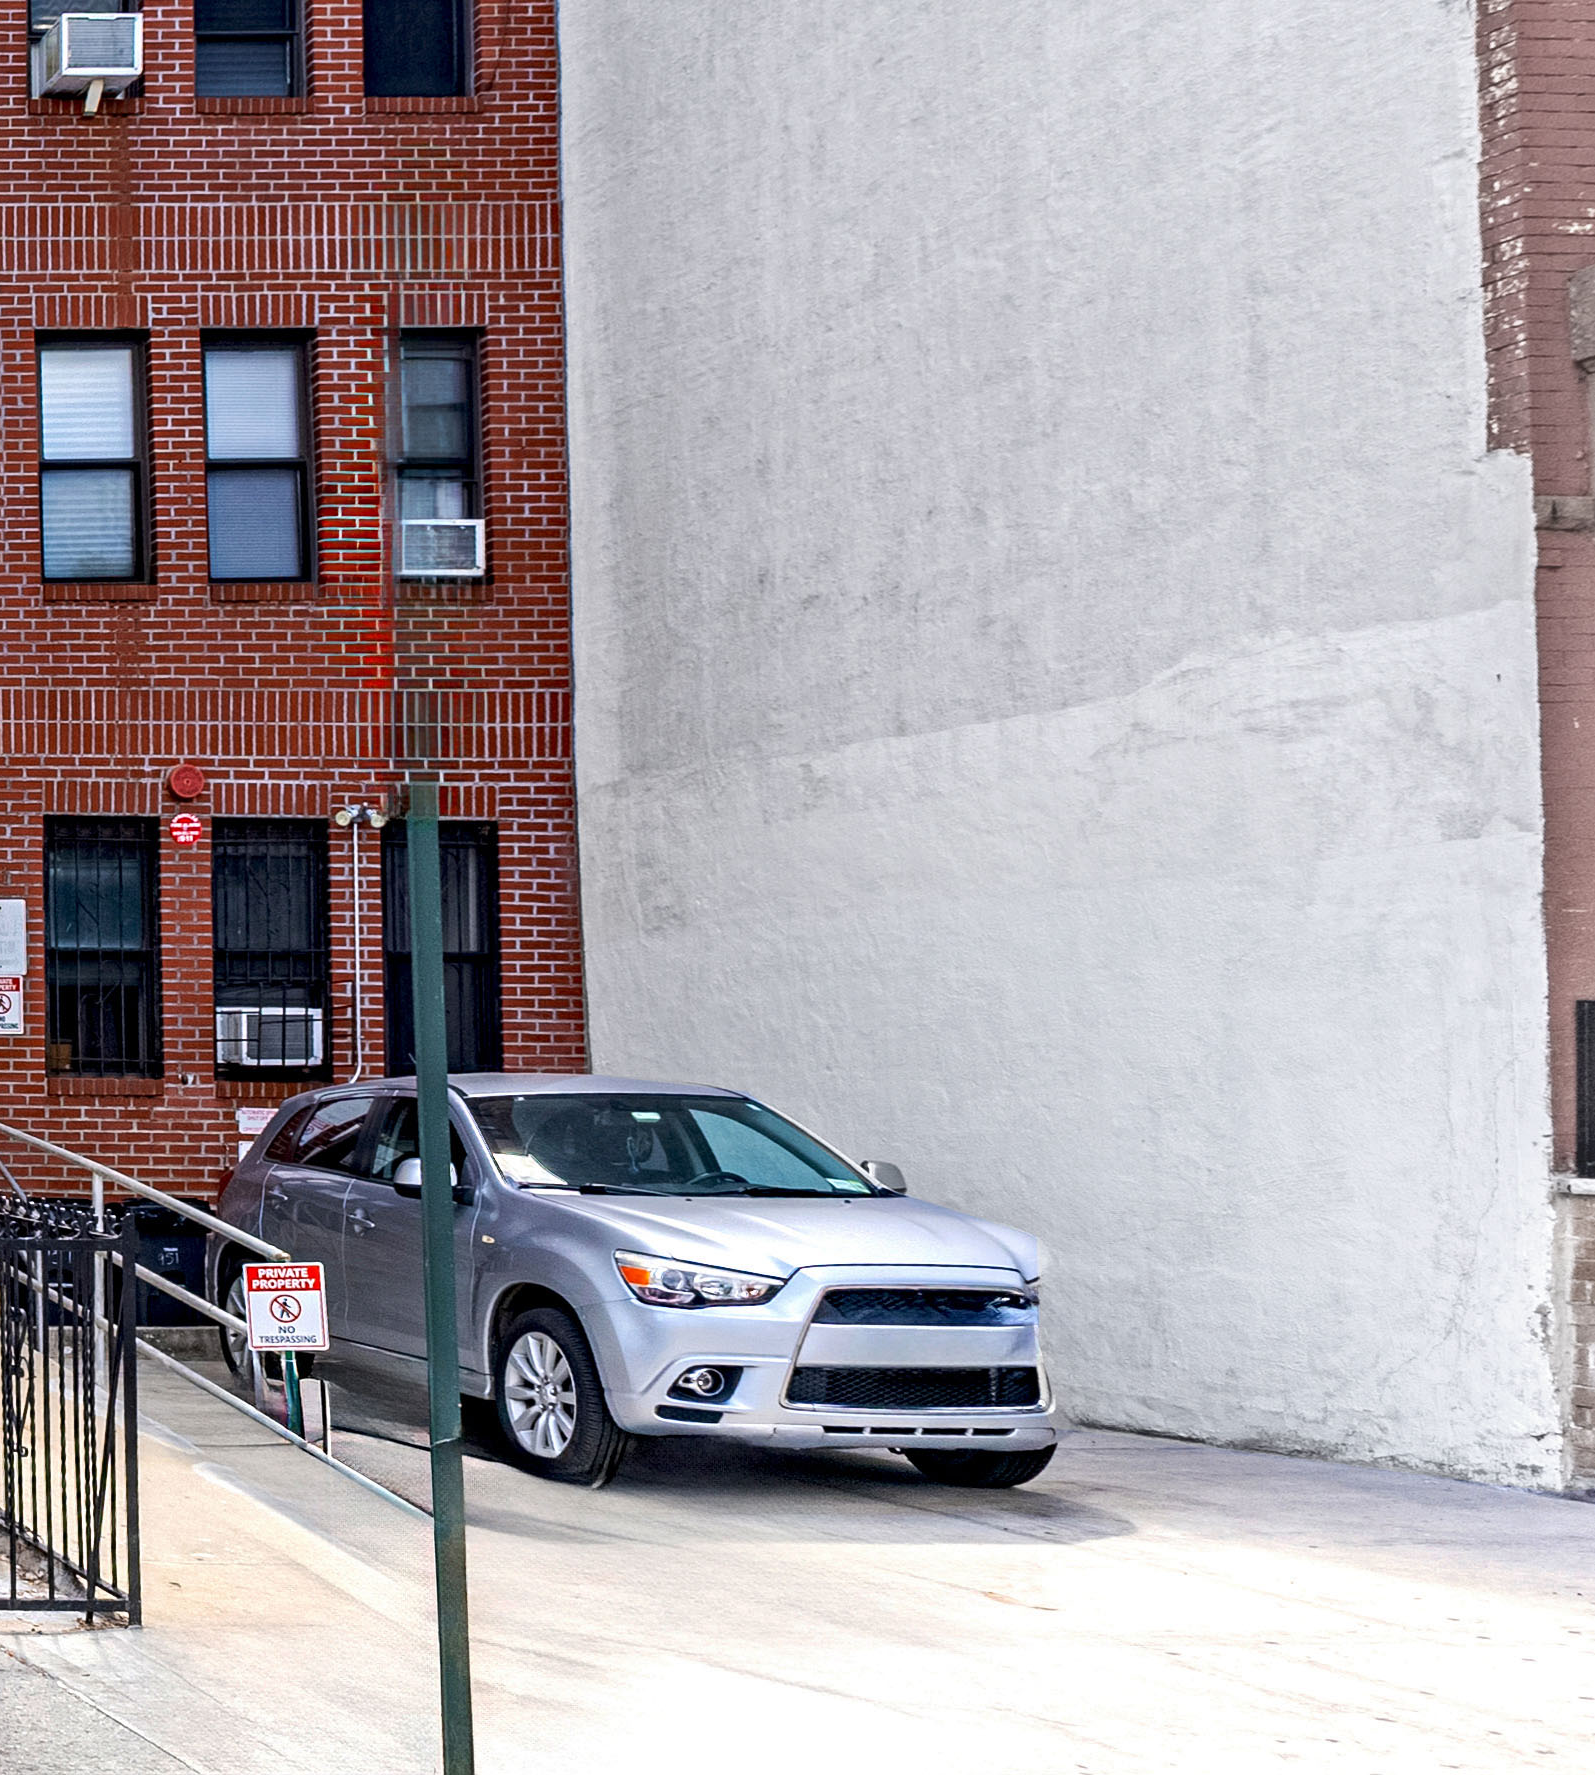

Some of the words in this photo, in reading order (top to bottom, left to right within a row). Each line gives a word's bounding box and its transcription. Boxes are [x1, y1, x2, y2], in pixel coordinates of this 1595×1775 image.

[258, 1268, 309, 1278] PRIVATE
[252, 1279, 316, 1290] PROPERTY
[278, 1325, 296, 1334] NO
[259, 1335, 317, 1344] TRESPASSING
